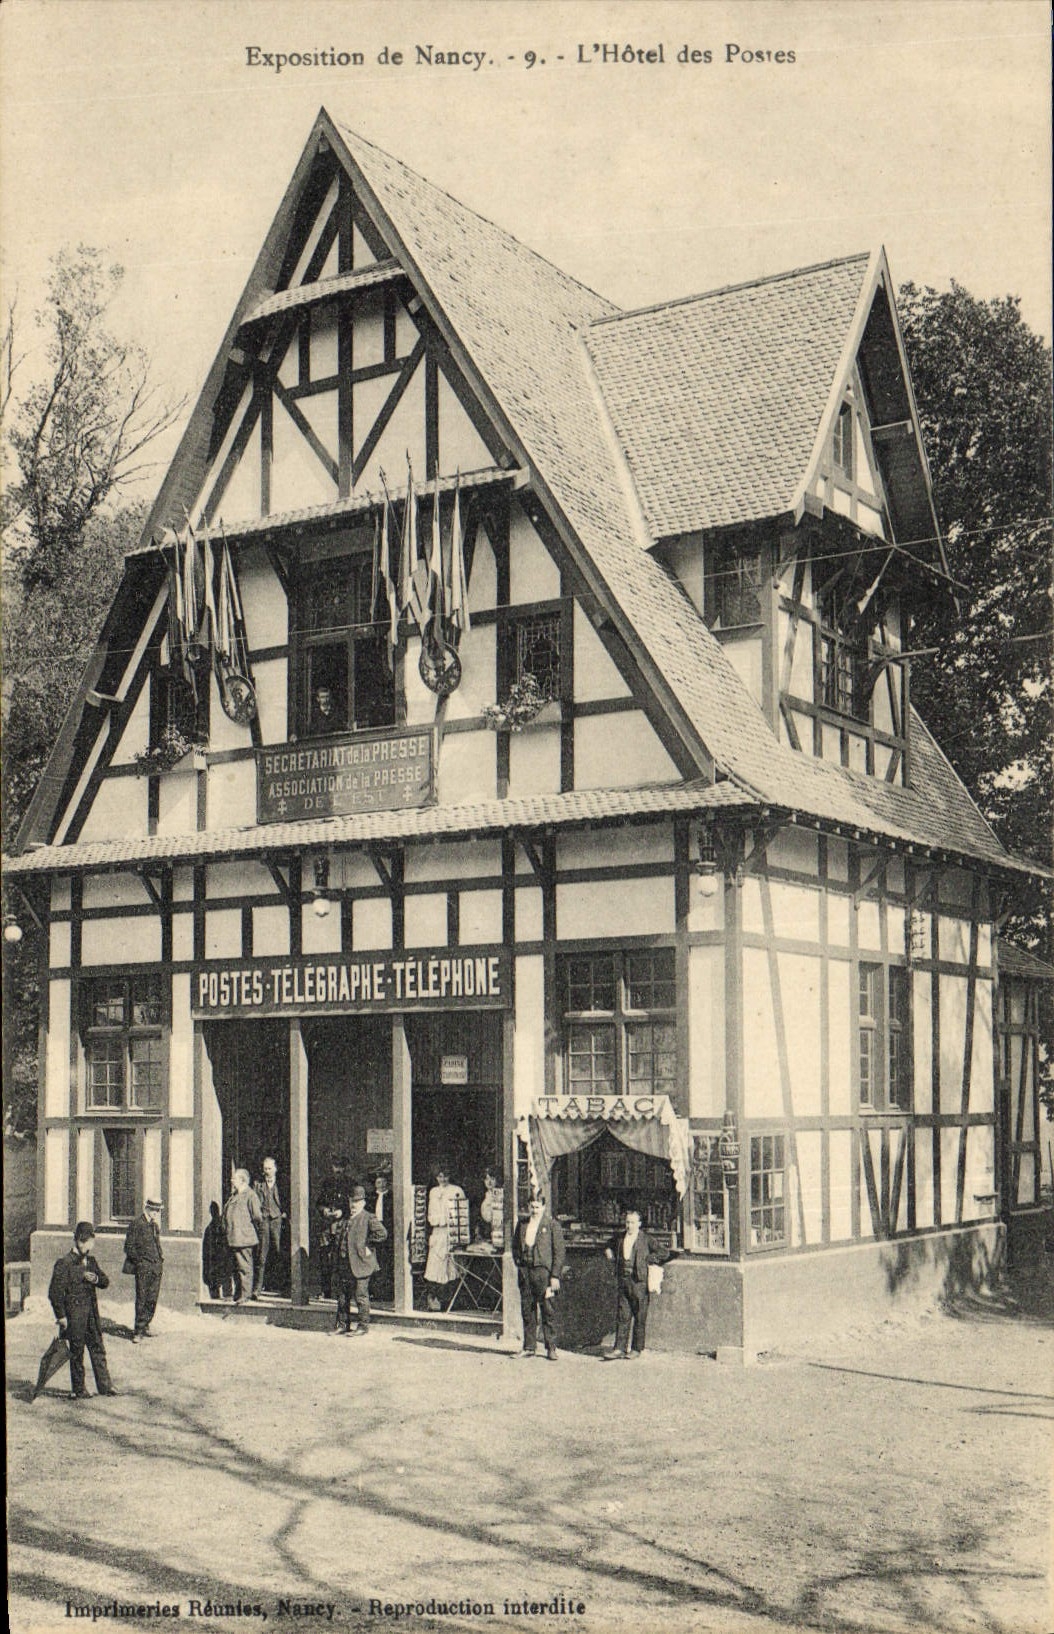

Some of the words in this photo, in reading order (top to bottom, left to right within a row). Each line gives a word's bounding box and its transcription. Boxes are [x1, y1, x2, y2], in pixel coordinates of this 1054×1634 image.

[347, 744, 359, 765] de
[360, 743, 370, 763] la
[373, 735, 427, 762] PRESSE
[268, 774, 343, 799] ASSOCIATION
[346, 773, 358, 790] de
[361, 771, 370, 788] la
[374, 766, 422, 787] PRESSE
[304, 796, 324, 811] DE
[538, 1096, 655, 1114] TABAC
